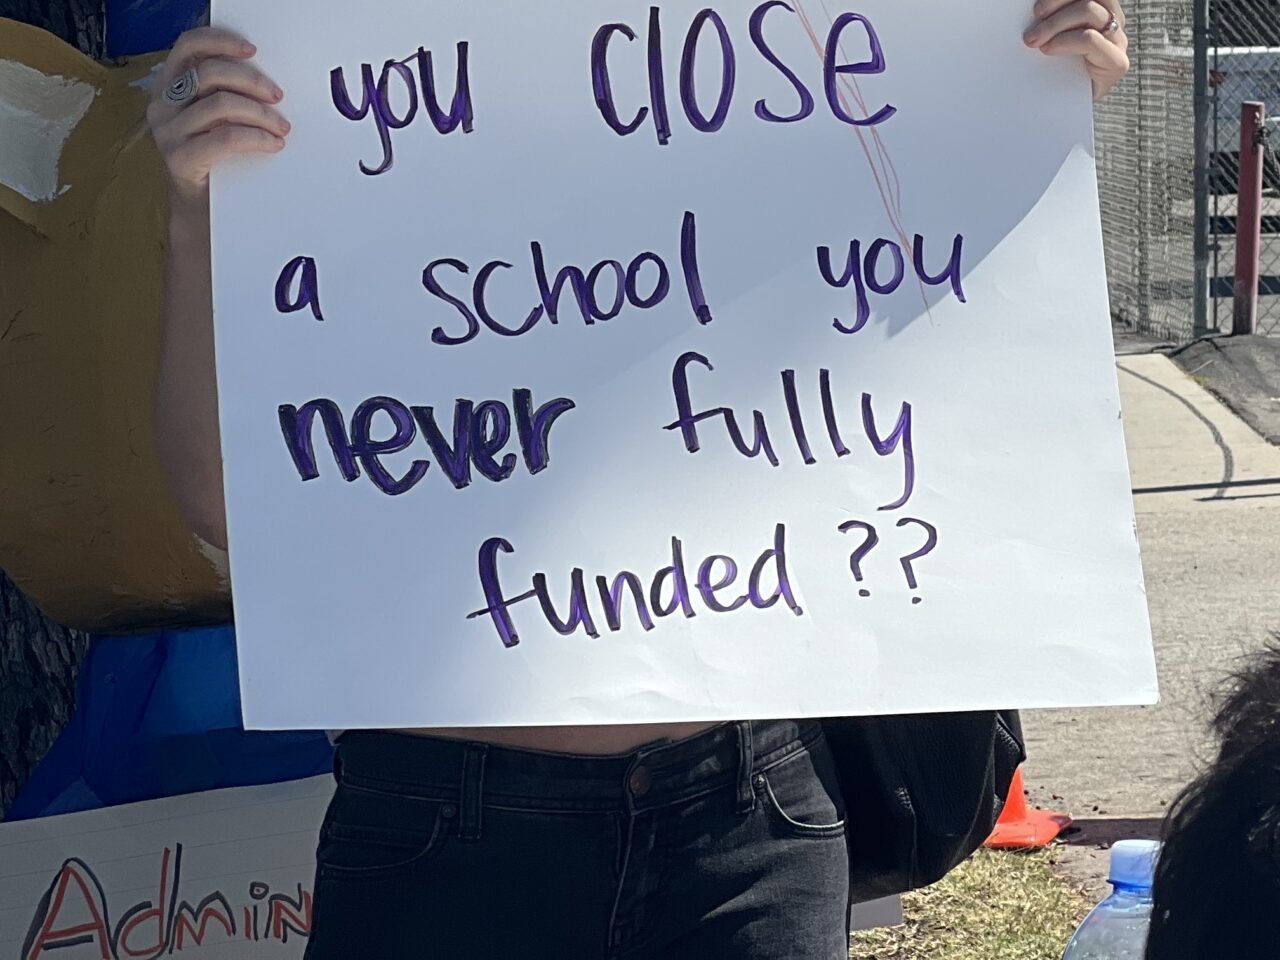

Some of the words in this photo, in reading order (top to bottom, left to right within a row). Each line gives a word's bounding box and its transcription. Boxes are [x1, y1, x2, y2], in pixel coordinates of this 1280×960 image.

[329, 40, 474, 176] you
[590, 0, 898, 146] close
[274, 255, 325, 322] a
[421, 210, 713, 346] school
[816, 233, 967, 335] you
[277, 387, 577, 496] never
[662, 351, 915, 511] fully
[465, 522, 805, 649] funded
